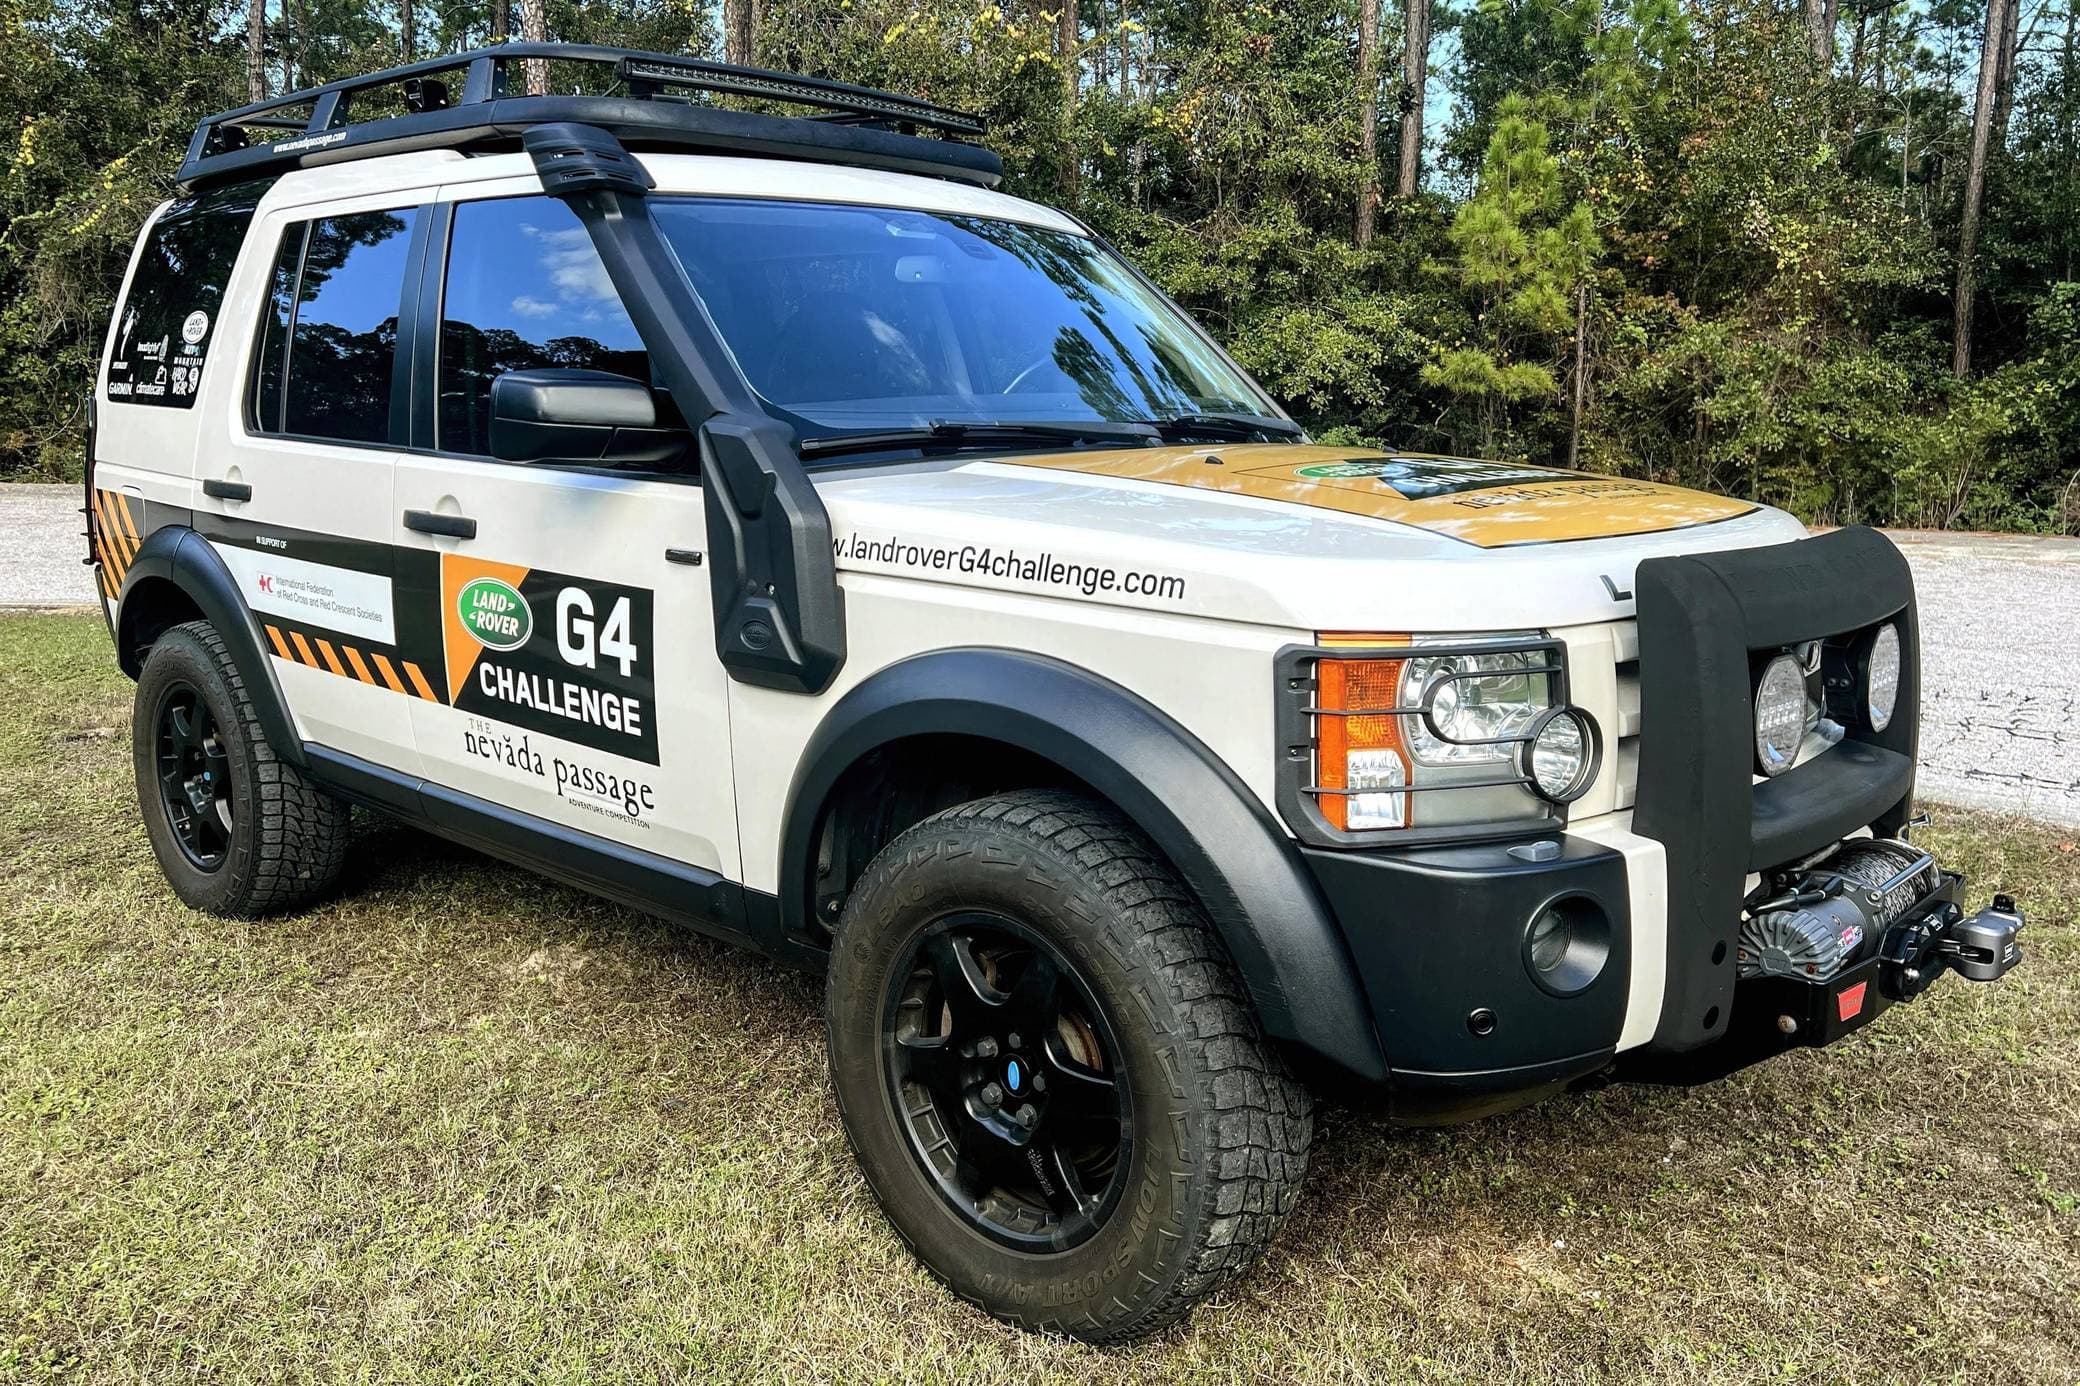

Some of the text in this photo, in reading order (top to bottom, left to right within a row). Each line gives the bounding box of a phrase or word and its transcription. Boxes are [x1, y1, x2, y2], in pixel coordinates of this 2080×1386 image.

[108, 381, 133, 395] GARMIN
[261, 536, 280, 548] SUPPORT
[276, 575, 334, 597] International Federation
[472, 589, 508, 612] LAND
[282, 590, 293, 602] Red
[294, 592, 309, 606] Cross
[309, 596, 319, 608] and
[319, 598, 331, 610] Red
[331, 601, 356, 617] Crescent
[356, 606, 383, 623] Societies
[476, 611, 519, 638] ROVER
[556, 586, 637, 678] G4
[479, 662, 642, 737] CHALLENGE
[468, 717, 492, 735] THE
[553, 757, 656, 818] passage
[569, 798, 650, 830] ADVENTURE COMPETITION
[1129, 1137, 1163, 1244] LION
[1042, 1236, 1136, 1307] SPORT
